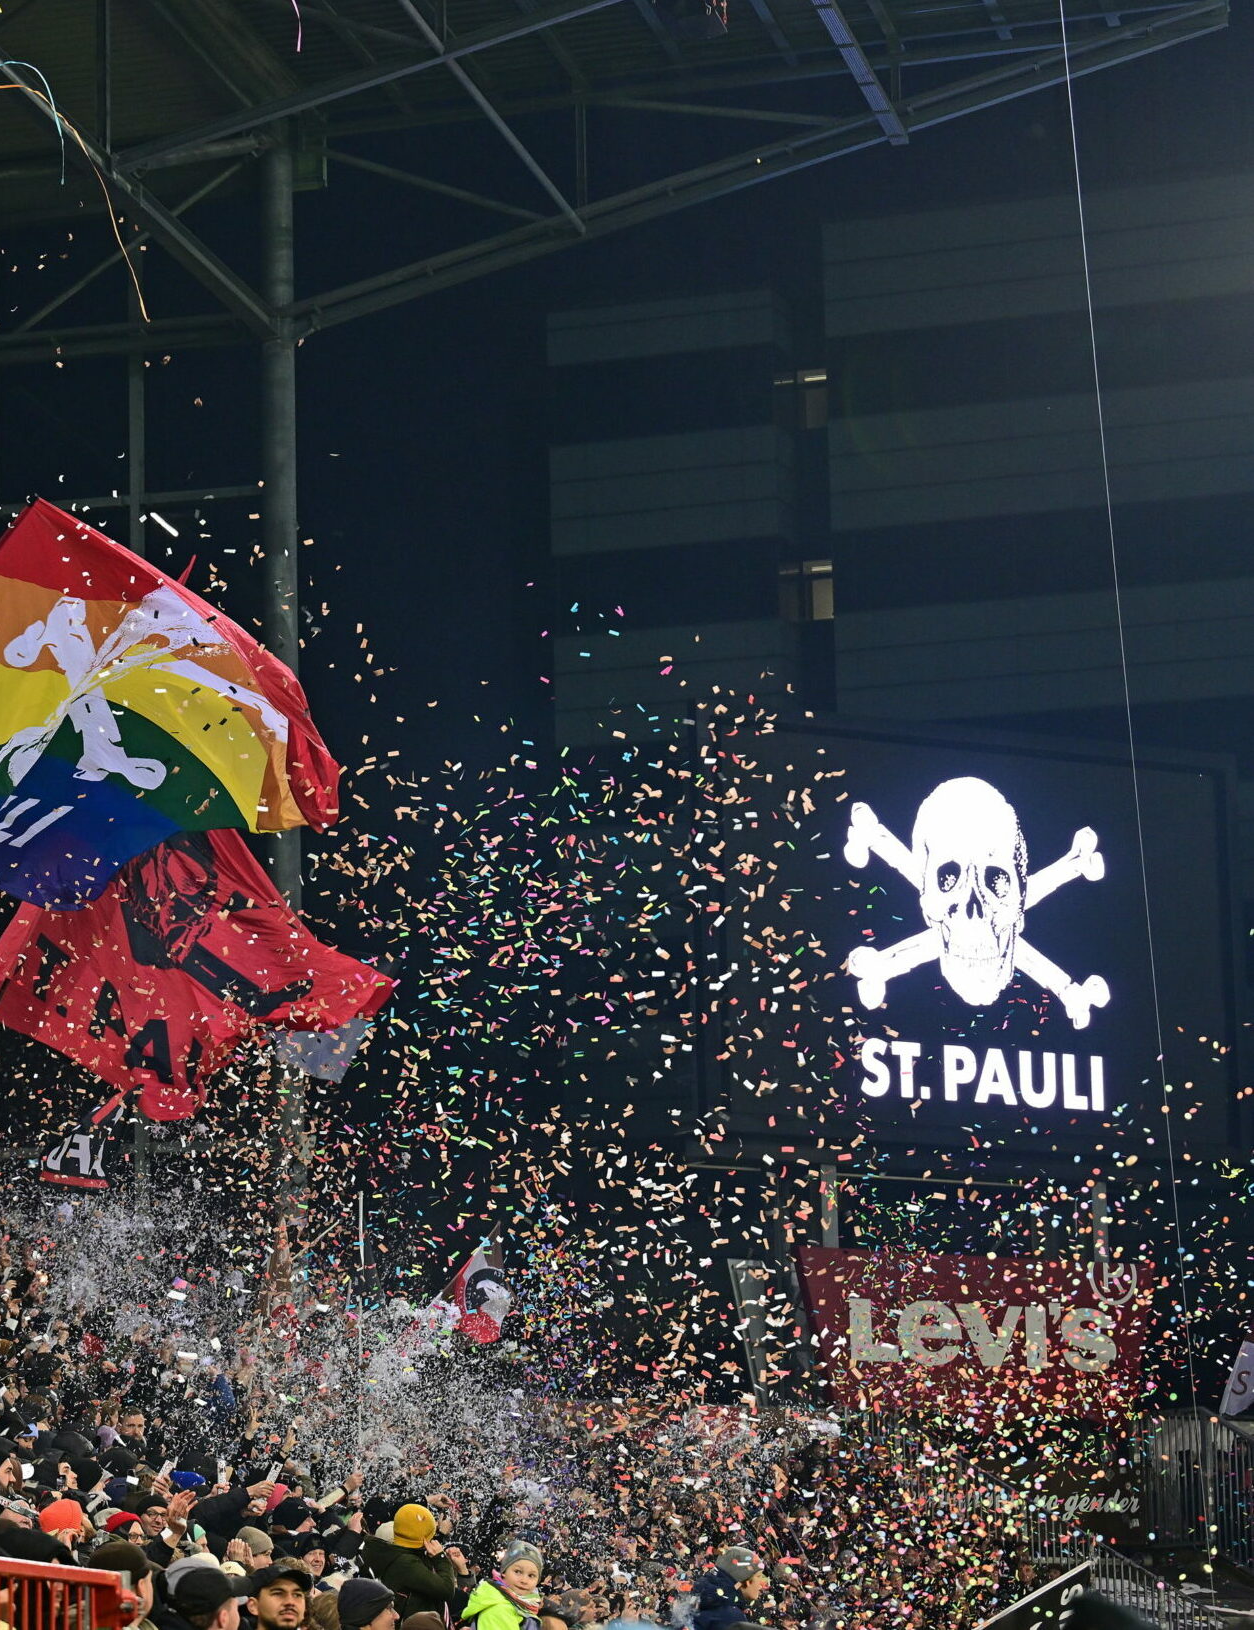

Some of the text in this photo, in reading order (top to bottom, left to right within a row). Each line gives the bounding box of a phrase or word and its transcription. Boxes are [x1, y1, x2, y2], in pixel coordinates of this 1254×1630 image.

[861, 1038, 1105, 1111] ST. PAULI
[1062, 1488, 1140, 1522] gender
